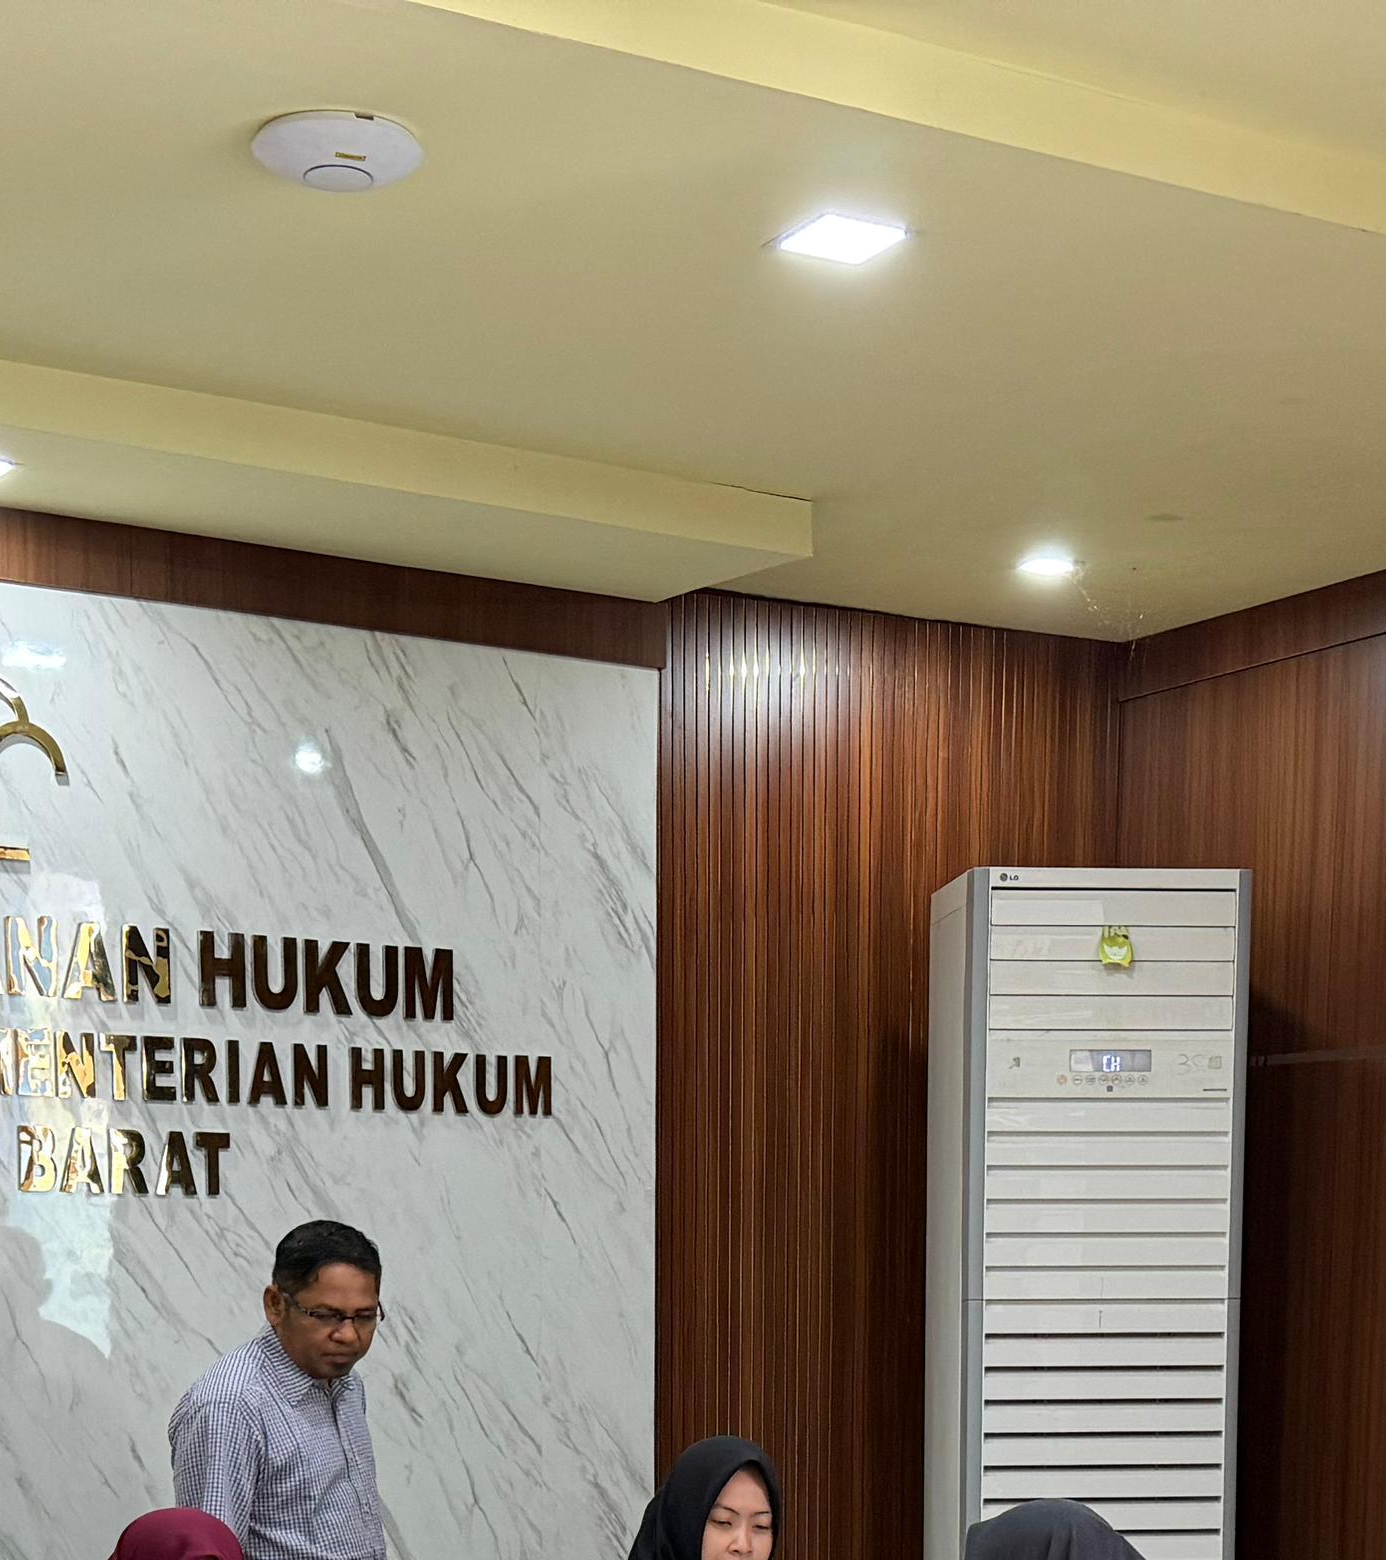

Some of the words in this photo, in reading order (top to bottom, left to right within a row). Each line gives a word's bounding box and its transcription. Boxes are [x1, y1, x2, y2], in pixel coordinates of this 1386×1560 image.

[197, 930, 455, 1021] HUKUM
[350, 1046, 553, 1116] HUKUM
[17, 1125, 231, 1196] BARAT
